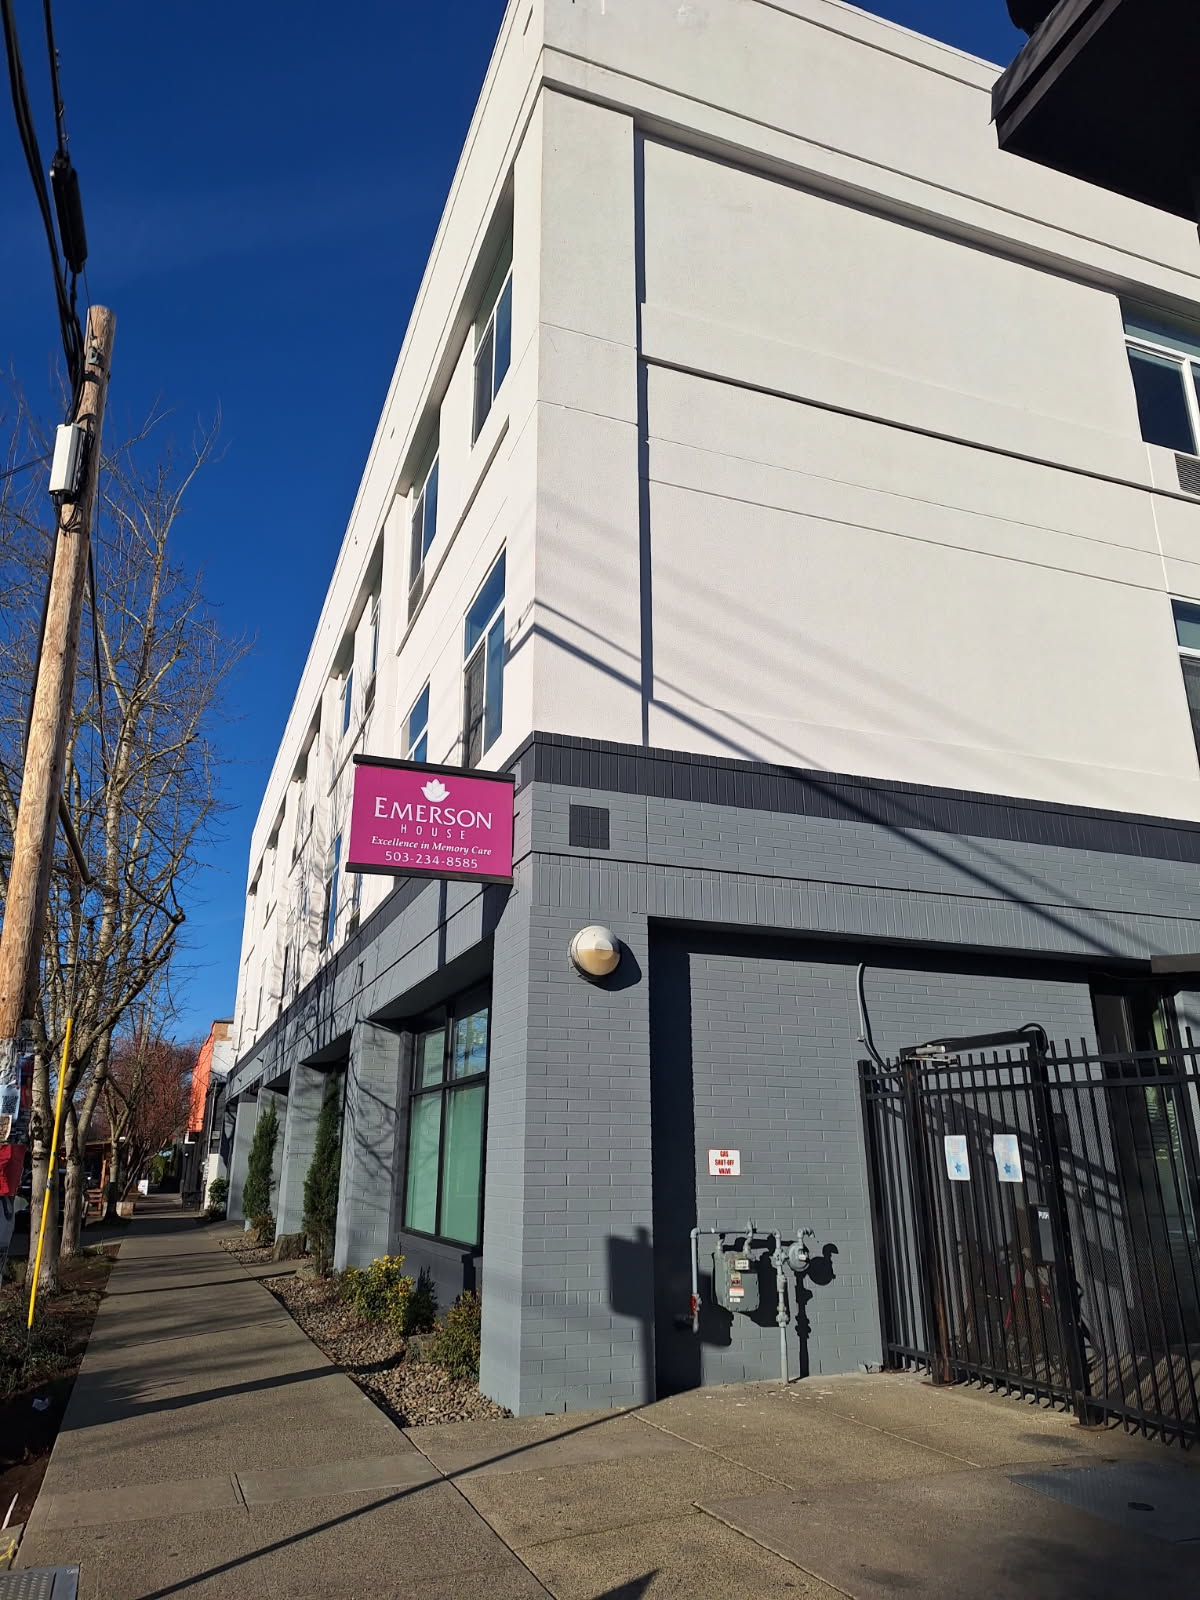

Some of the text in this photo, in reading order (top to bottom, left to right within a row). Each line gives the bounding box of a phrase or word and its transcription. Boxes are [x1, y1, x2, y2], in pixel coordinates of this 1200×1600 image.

[375, 796, 492, 830] EMERSON
[400, 824, 466, 840] HOUSE
[371, 835, 492, 856] Excellence in Memory Care
[385, 851, 478, 869] 503-234-8585
